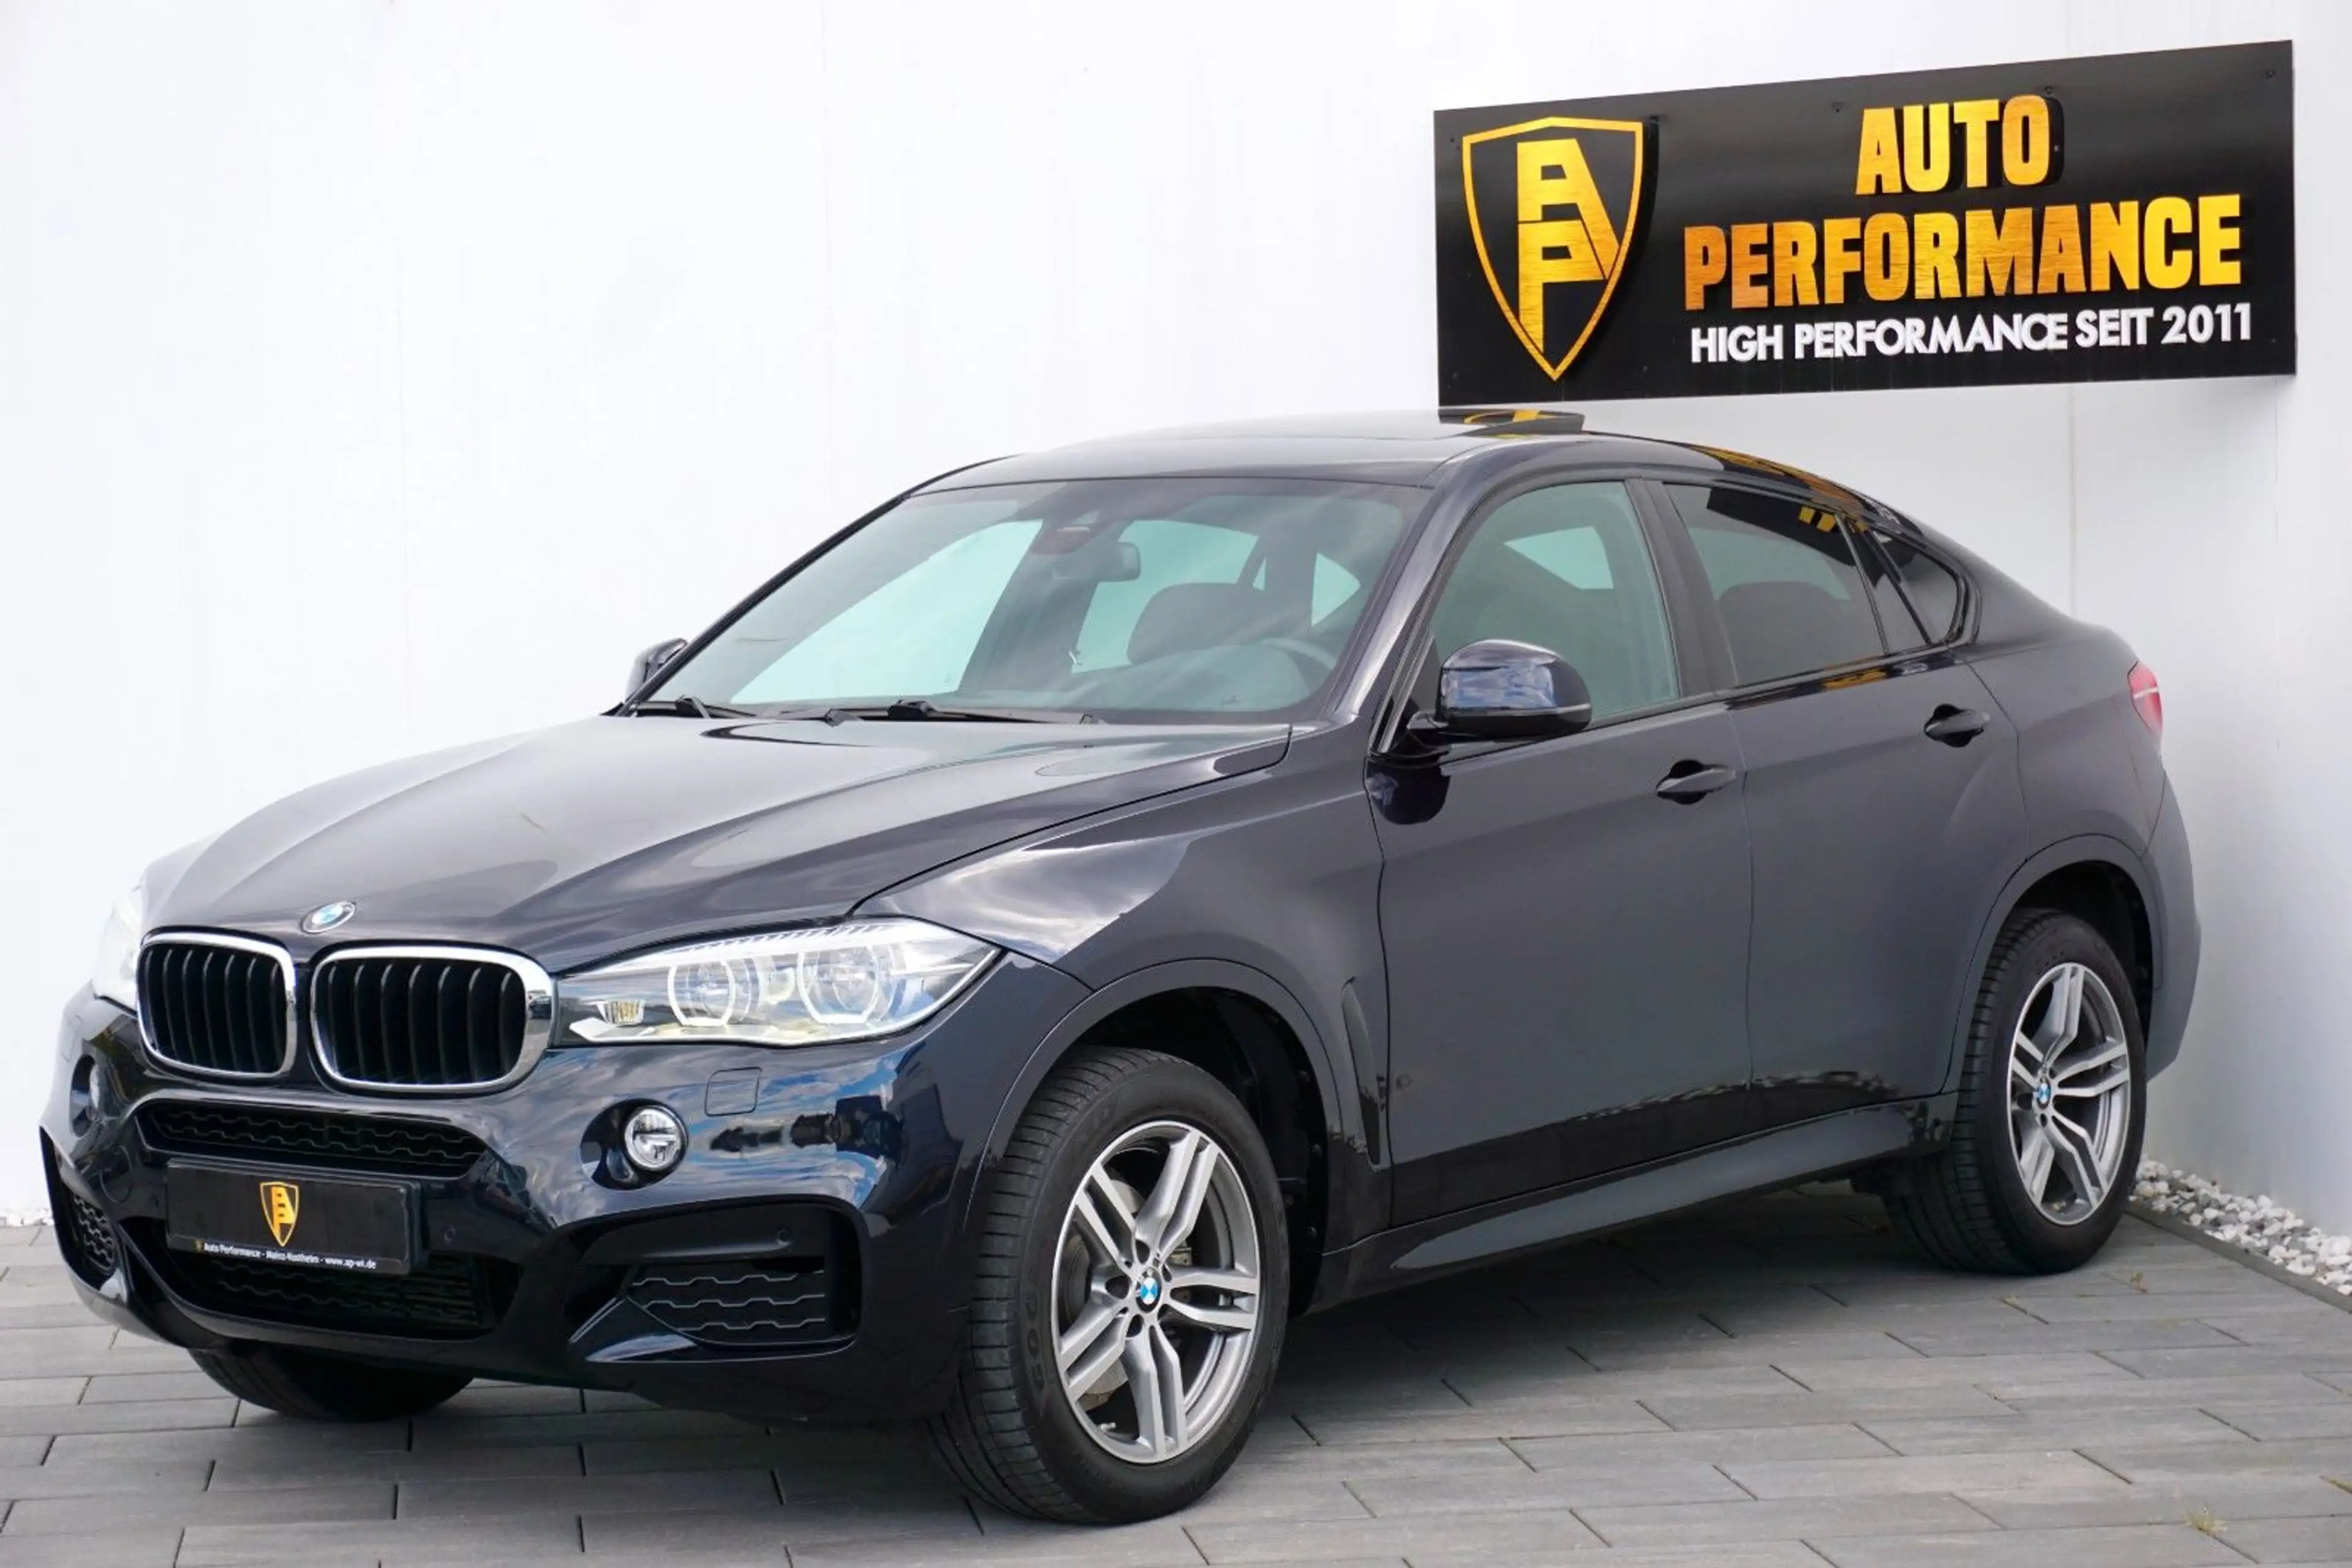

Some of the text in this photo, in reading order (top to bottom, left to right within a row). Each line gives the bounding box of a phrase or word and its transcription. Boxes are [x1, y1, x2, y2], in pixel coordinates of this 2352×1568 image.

[1855, 94, 2051, 195] AUTO
[1684, 194, 2241, 311] PERFORMANCE
[1691, 303, 2252, 363] HIGH PERFORMANCE SEIT 2011
